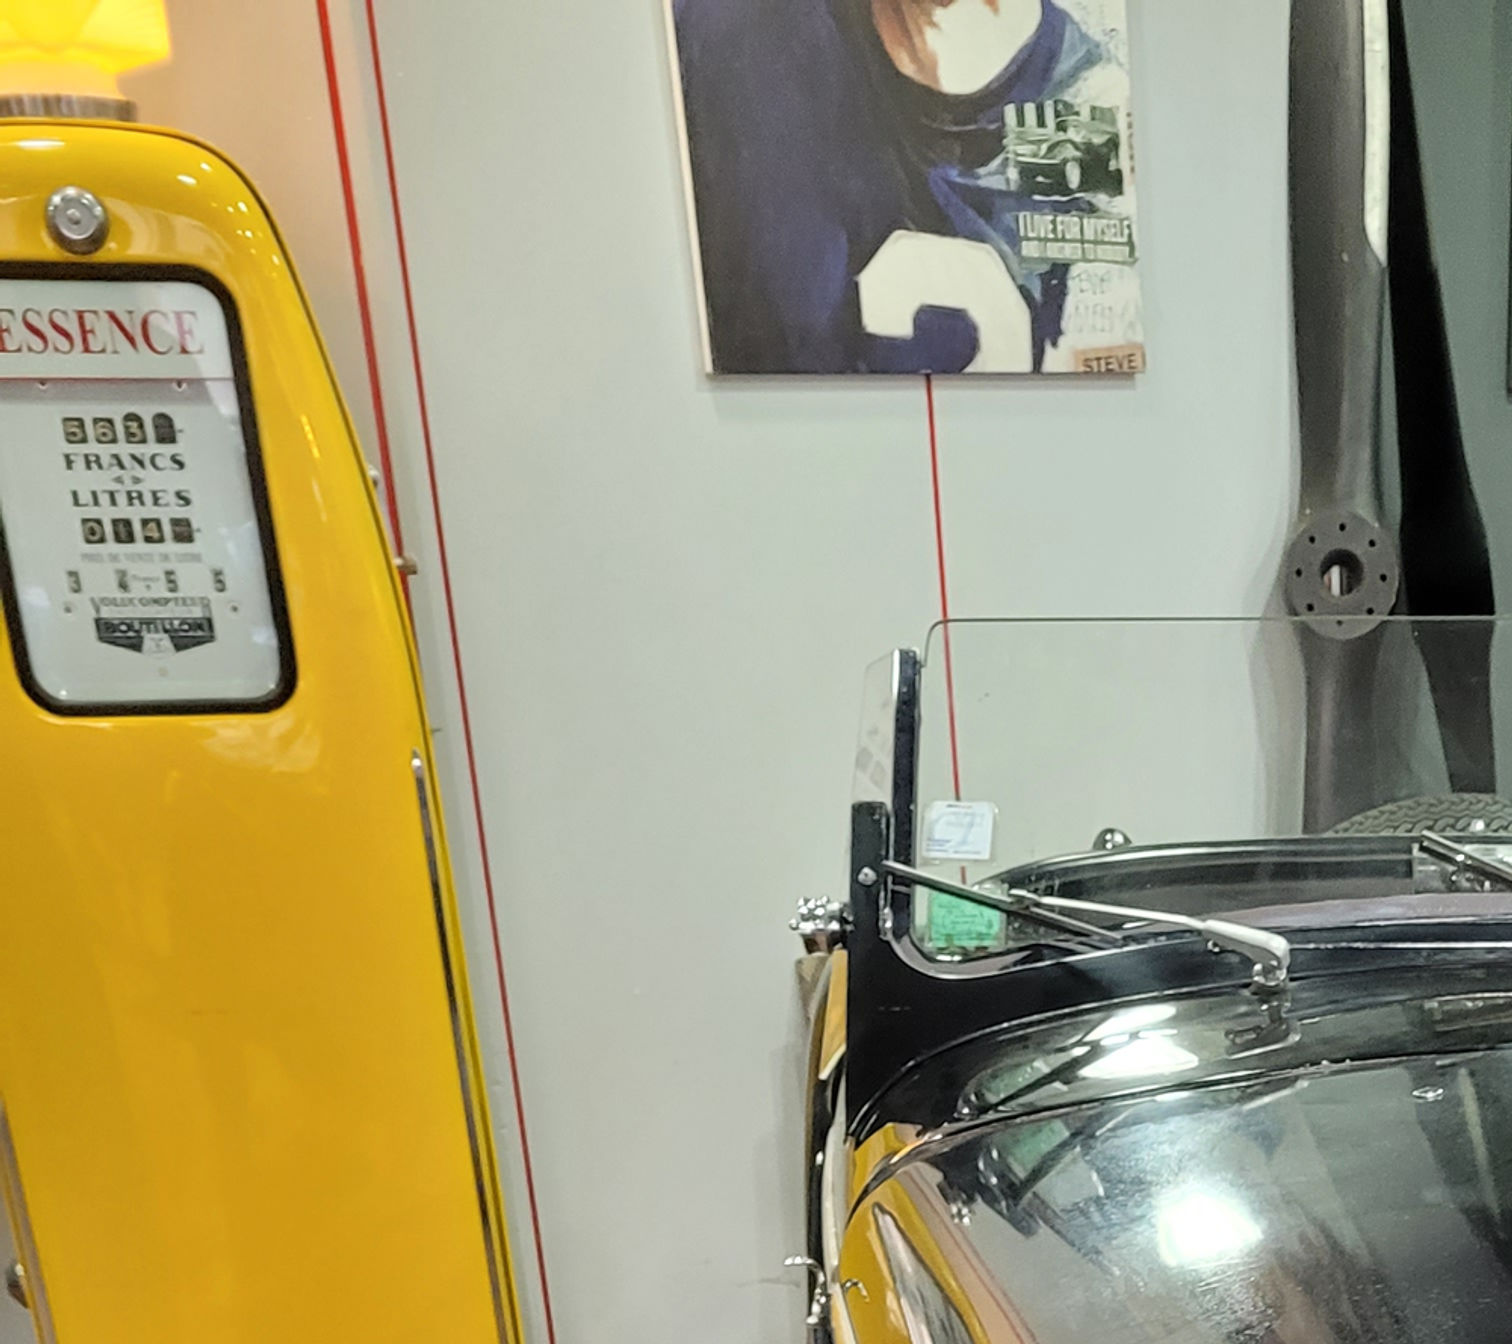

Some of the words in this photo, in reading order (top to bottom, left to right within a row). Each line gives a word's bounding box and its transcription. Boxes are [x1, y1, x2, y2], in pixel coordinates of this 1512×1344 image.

[1027, 213, 1056, 239] LIVE
[1056, 215, 1082, 240] FOR
[1083, 217, 1131, 243] MYSELF
[0, 307, 204, 356] ESSENCE
[1082, 352, 1138, 373] STEVE
[63, 453, 186, 471] FRANCS
[71, 489, 192, 508] LITRES
